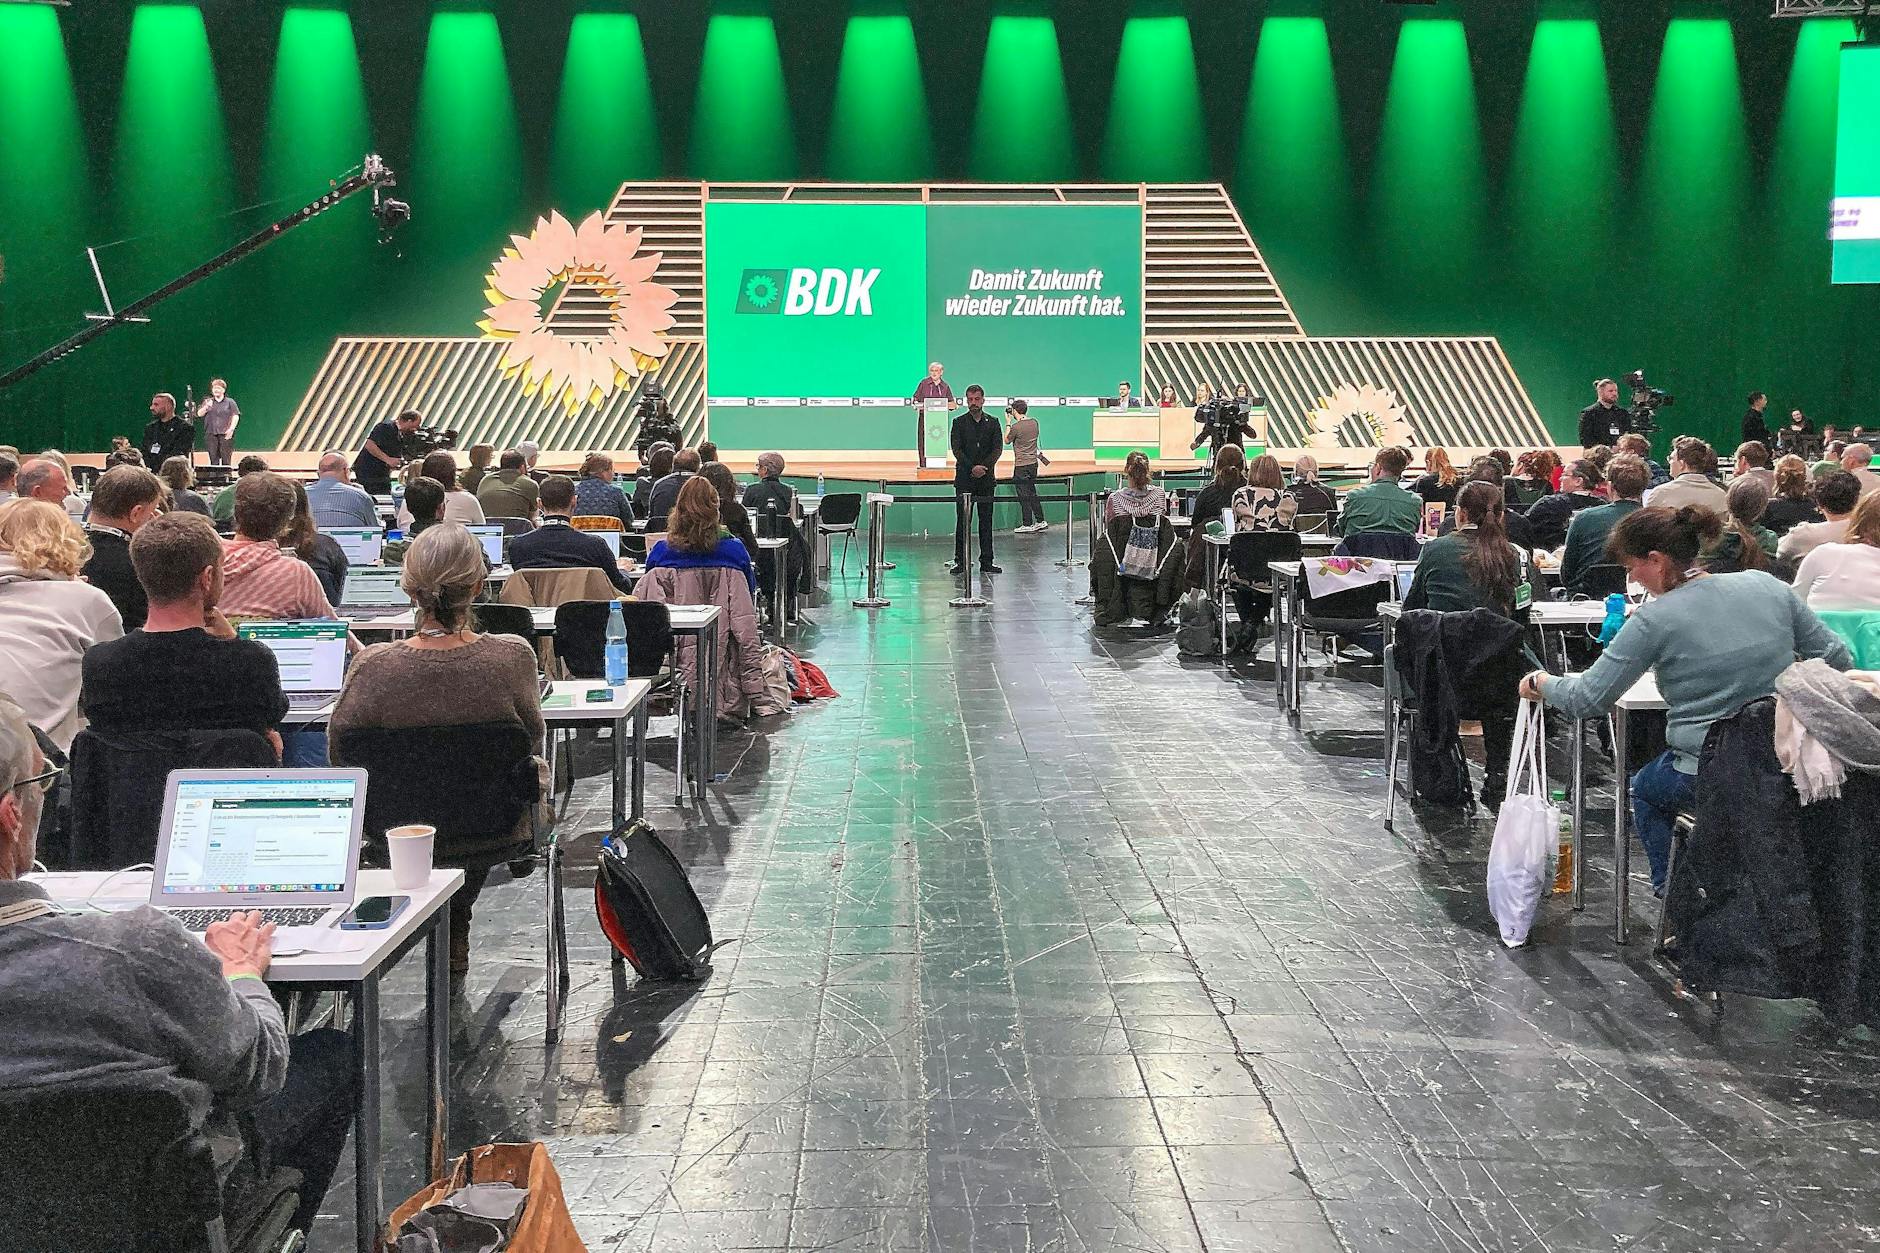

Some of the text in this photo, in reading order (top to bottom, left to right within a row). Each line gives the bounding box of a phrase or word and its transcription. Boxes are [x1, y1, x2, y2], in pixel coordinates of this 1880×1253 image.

[969, 268, 1104, 291] Damit Zukunft
[784, 267, 881, 316] BDK
[945, 294, 1126, 316] wieder Zukunft hat.
